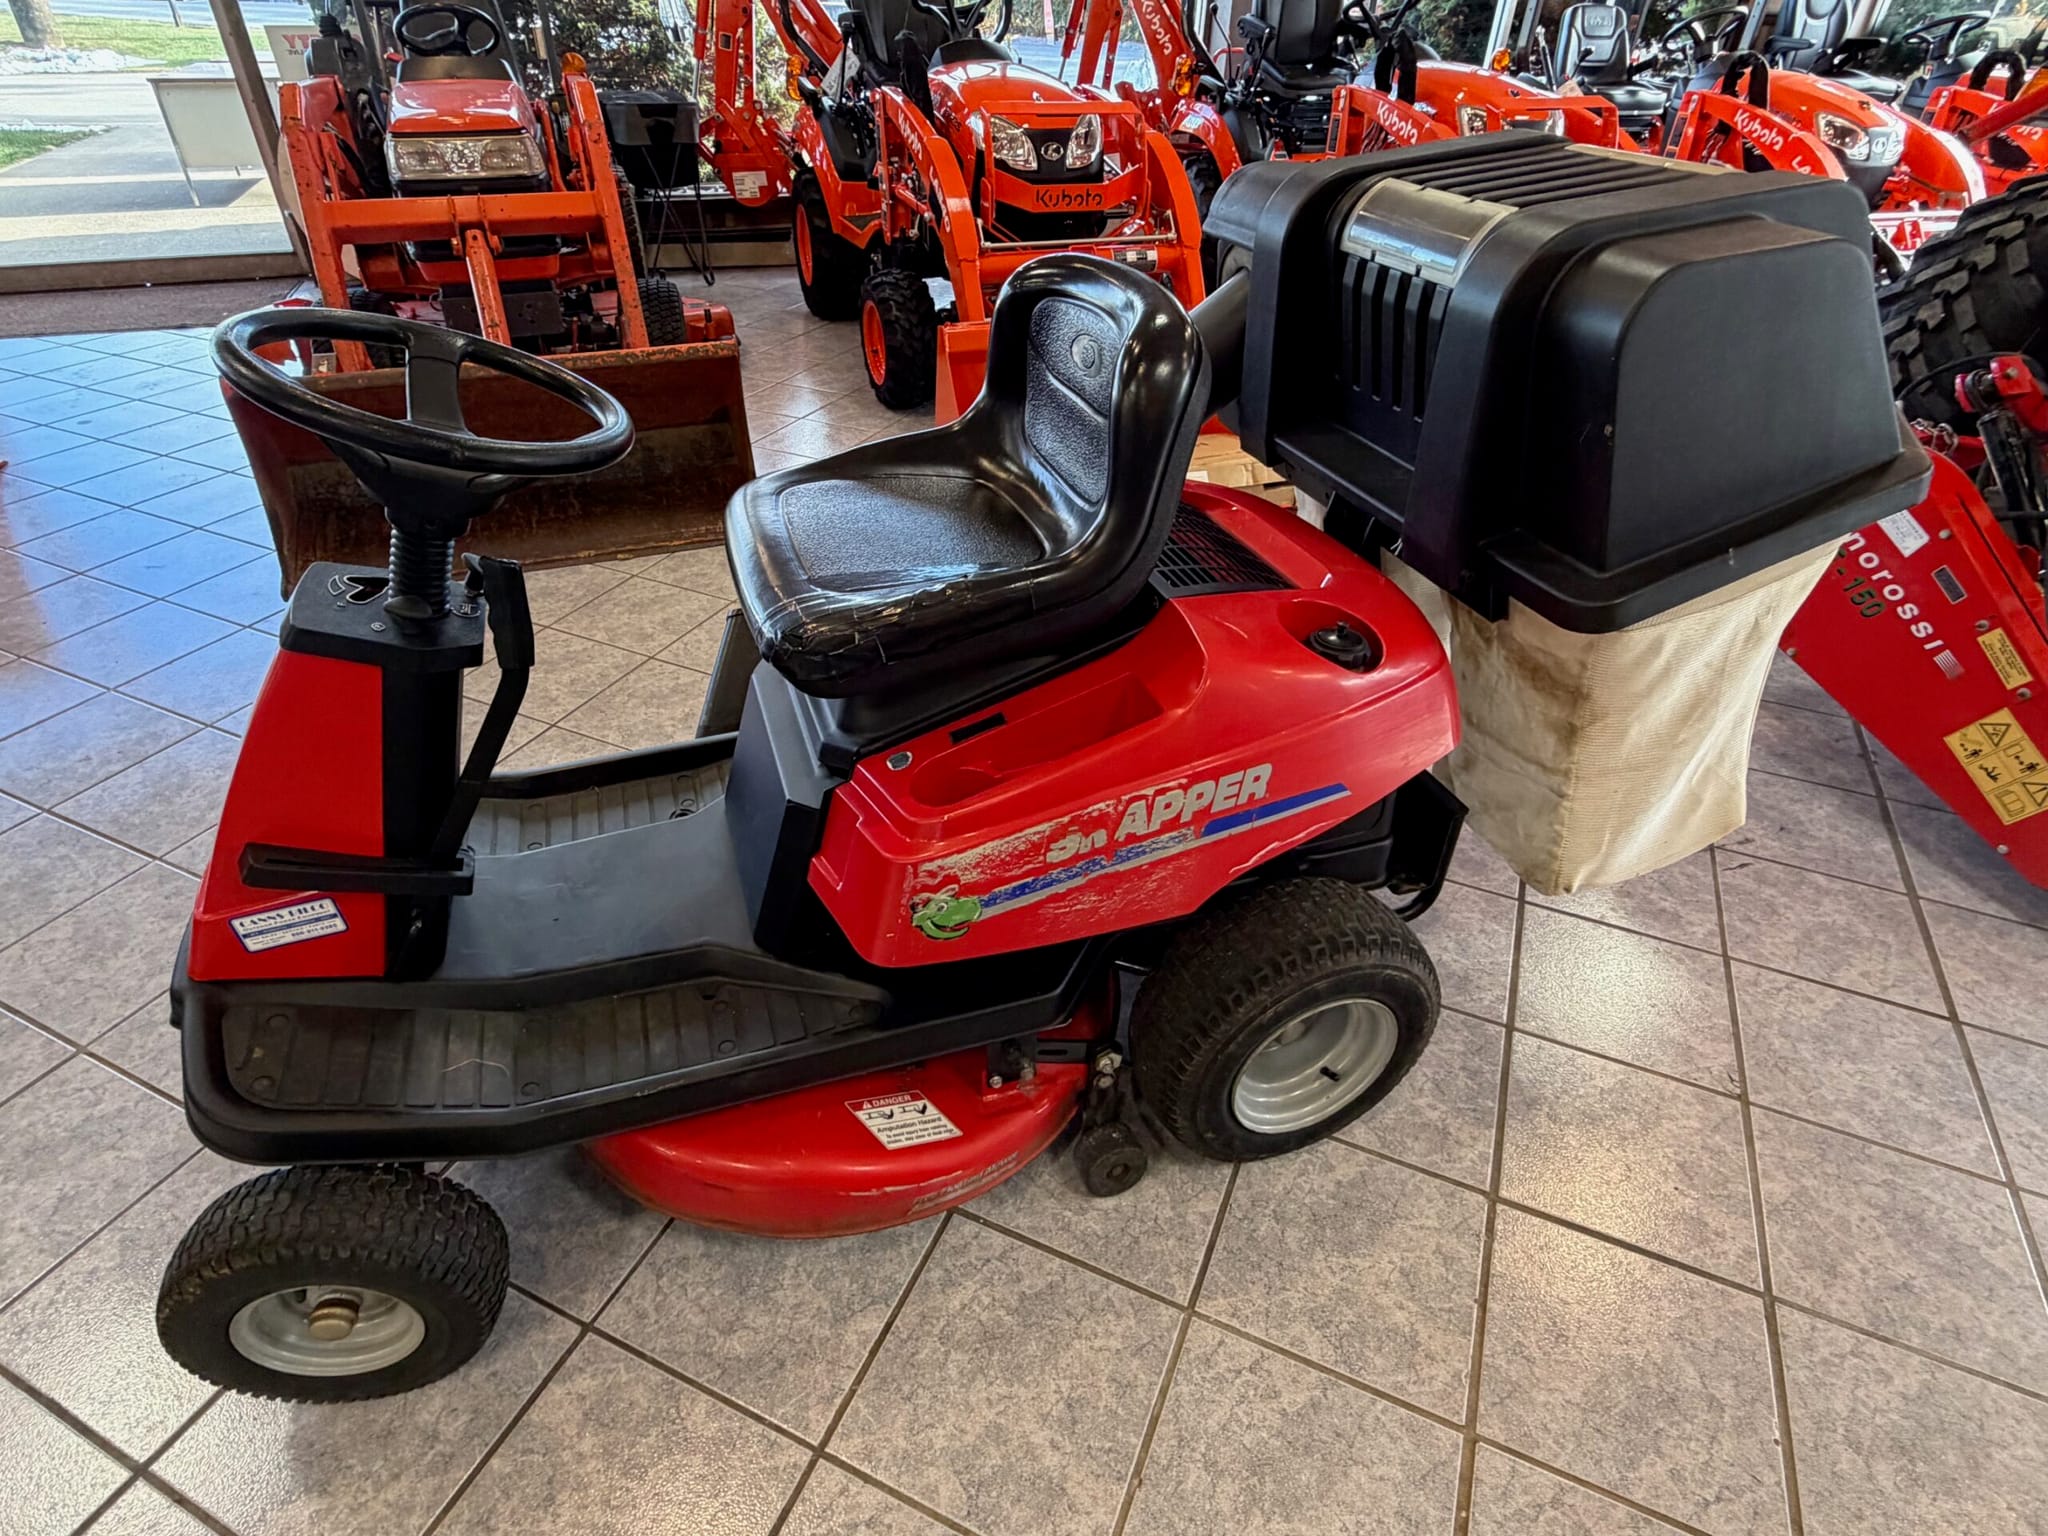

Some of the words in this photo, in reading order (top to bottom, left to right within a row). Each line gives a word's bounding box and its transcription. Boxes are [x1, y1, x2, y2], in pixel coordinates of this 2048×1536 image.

[1143, 1, 1172, 56] Kubota
[1376, 100, 1419, 145] Kubota
[1733, 107, 1785, 152] Kubota
[1036, 188, 1103, 208] Kubota
[872, 1094, 913, 1108] DANGER
[877, 1120, 918, 1134] Amputation
[916, 1115, 943, 1128] Hazard
